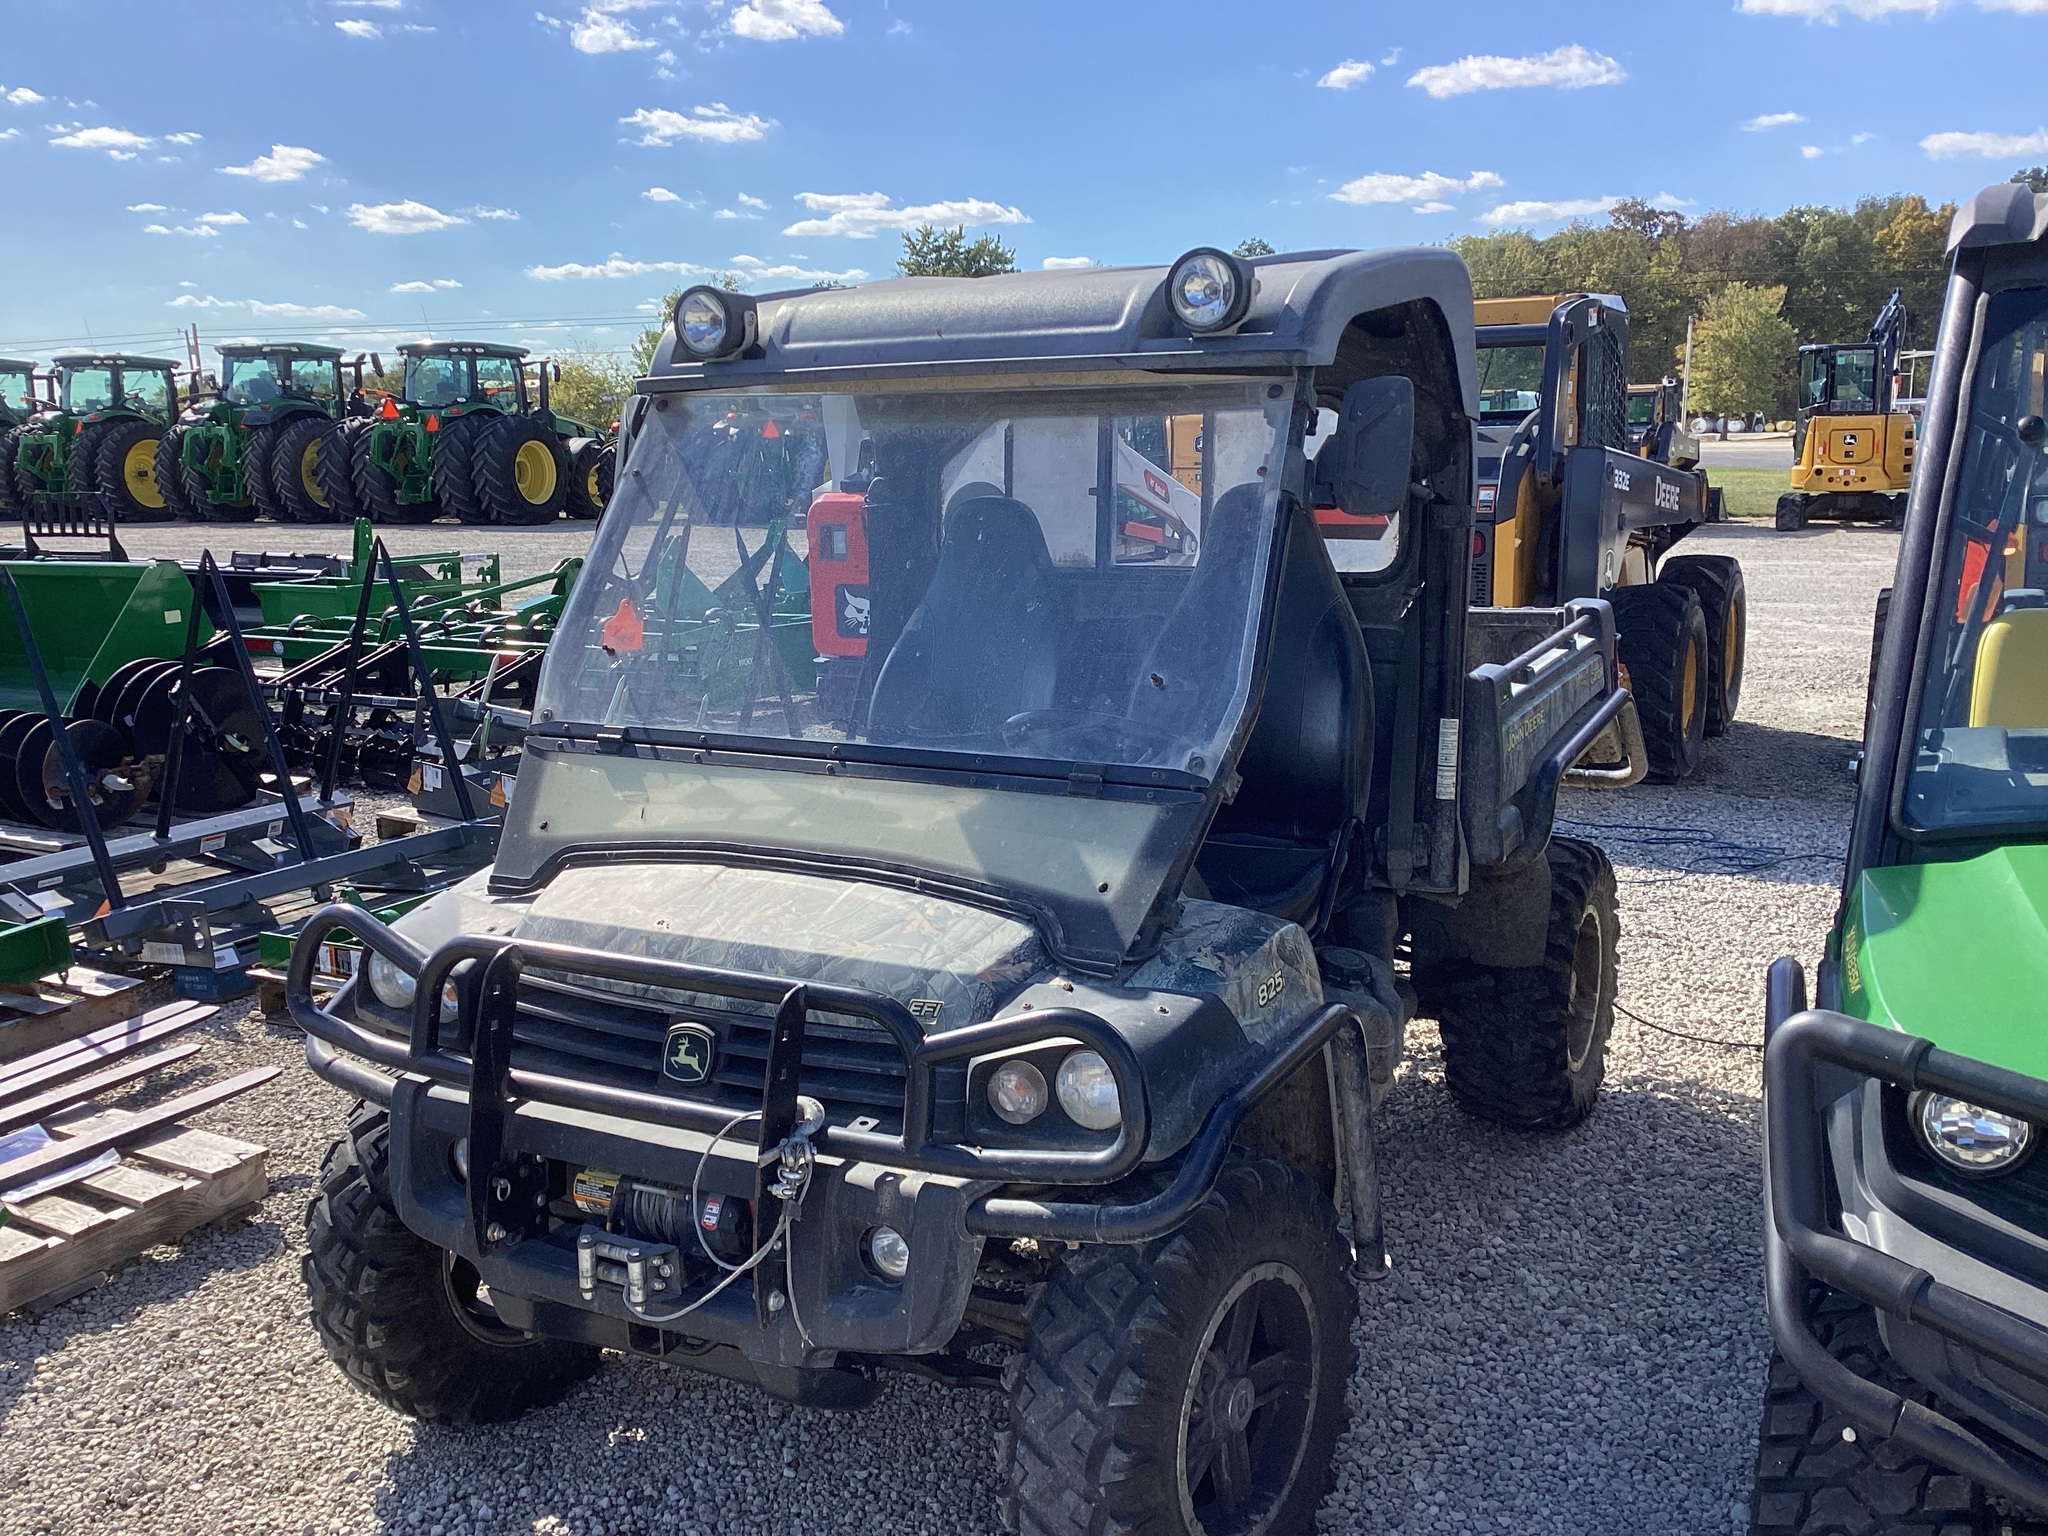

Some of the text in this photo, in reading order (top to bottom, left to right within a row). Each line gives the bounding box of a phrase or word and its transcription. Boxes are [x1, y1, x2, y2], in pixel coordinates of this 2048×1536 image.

[1614, 469, 1630, 491] 332E
[1655, 475, 1680, 511] DEERE
[1507, 709, 1545, 752] JOHN DEERE
[909, 1001, 942, 1017] EFI
